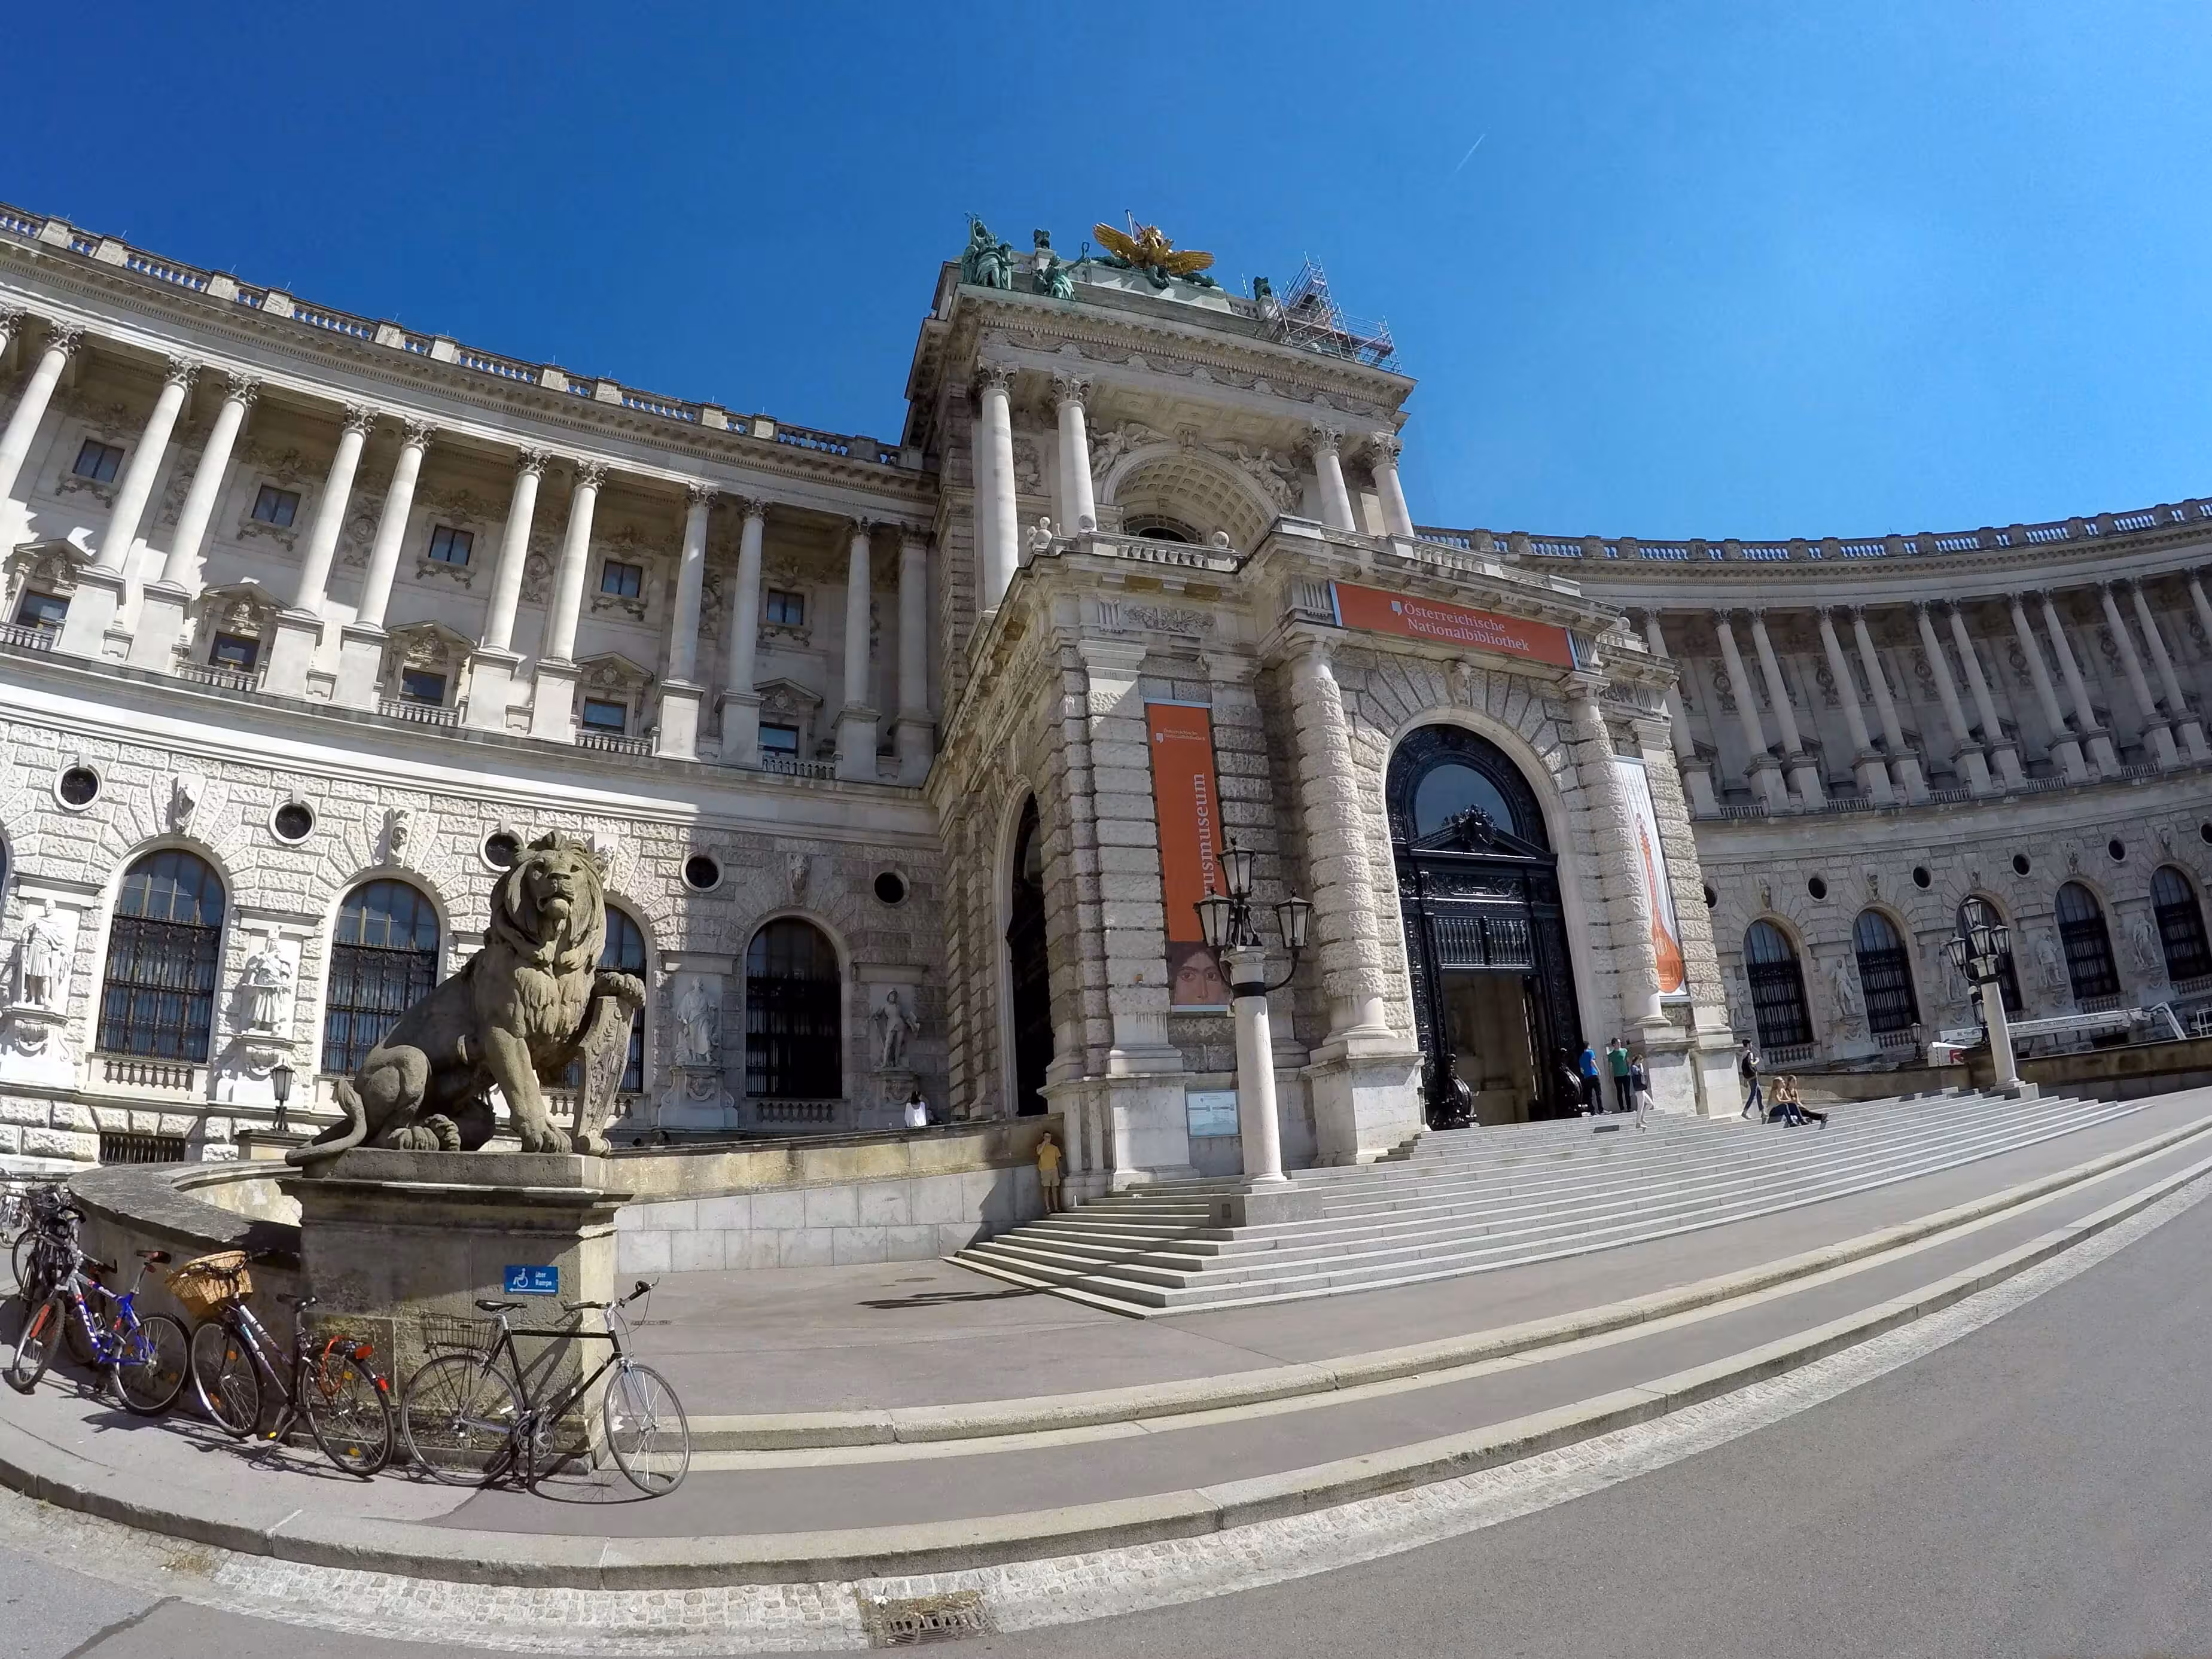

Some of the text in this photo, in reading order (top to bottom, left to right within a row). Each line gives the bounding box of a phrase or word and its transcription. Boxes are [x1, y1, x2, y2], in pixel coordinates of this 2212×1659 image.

[1404, 600, 1506, 632] Österreichische
[1407, 618, 1529, 651] Nationalbibliothek
[1194, 773, 1217, 898] rusmuseum
[535, 1279, 552, 1288] Rampe
